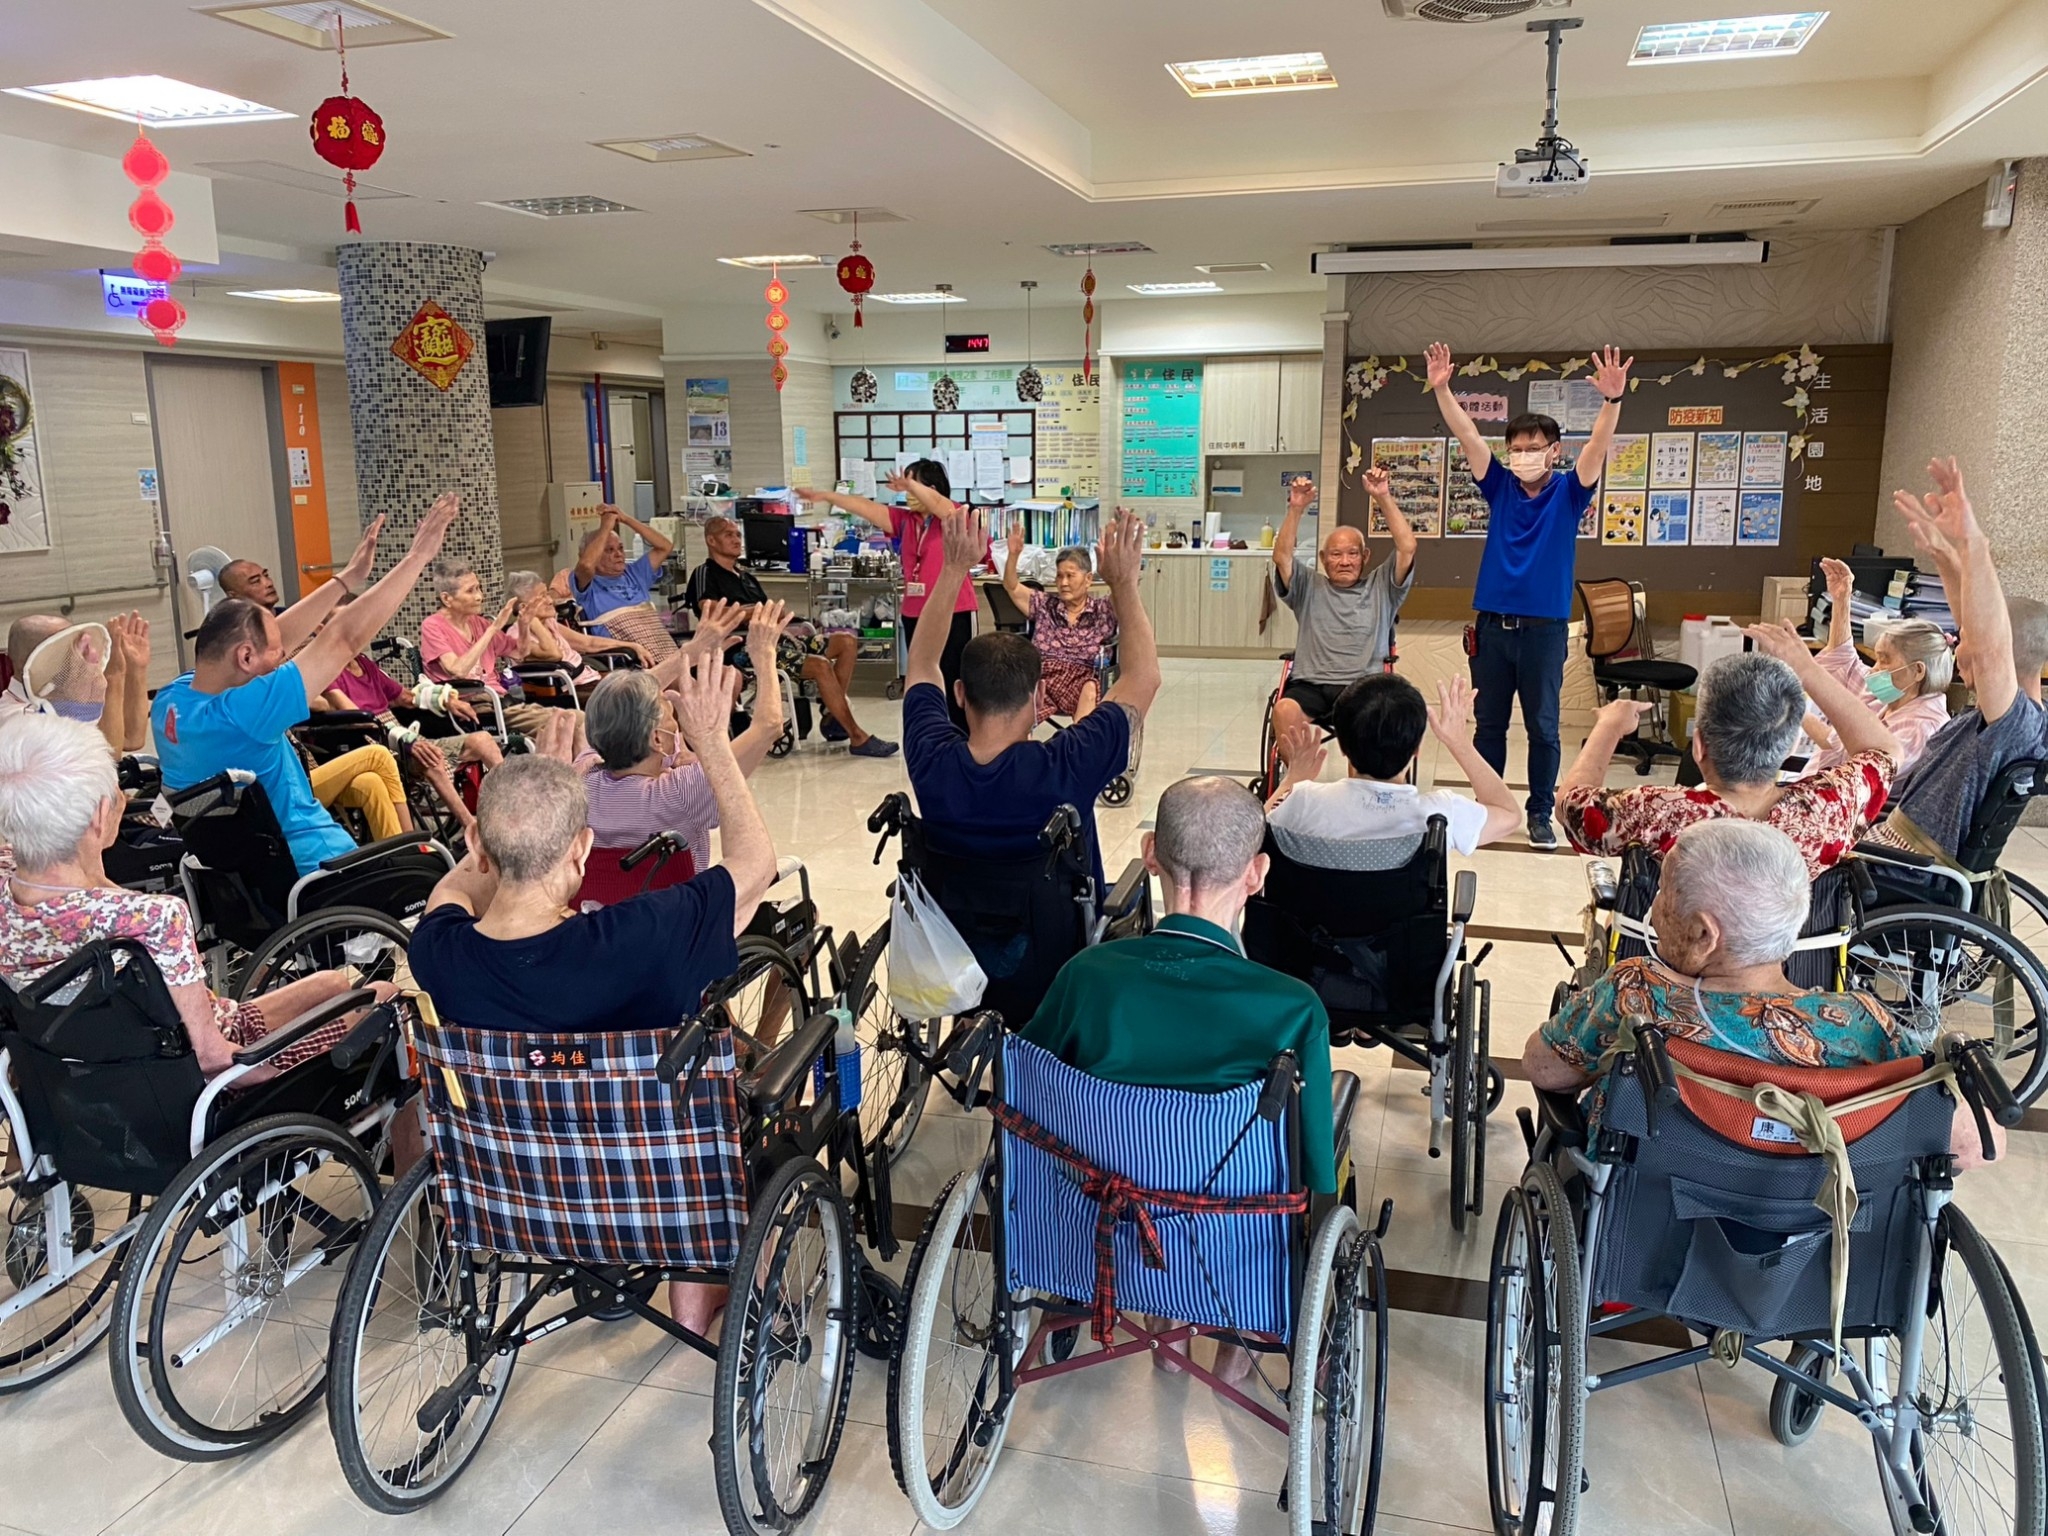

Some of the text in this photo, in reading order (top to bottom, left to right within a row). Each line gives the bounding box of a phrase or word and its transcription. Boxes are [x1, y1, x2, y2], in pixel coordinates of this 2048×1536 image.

[1071, 373, 1100, 387] 住民
[1162, 368, 1194, 382] 住民
[298, 403, 306, 436] 110
[1671, 408, 1721, 424] 防疫新知
[713, 421, 728, 437] 13
[1804, 373, 1831, 491] 生活園地
[404, 899, 426, 913] soma
[550, 1049, 587, 1067] 均佳
[1760, 1121, 1775, 1134] 康
